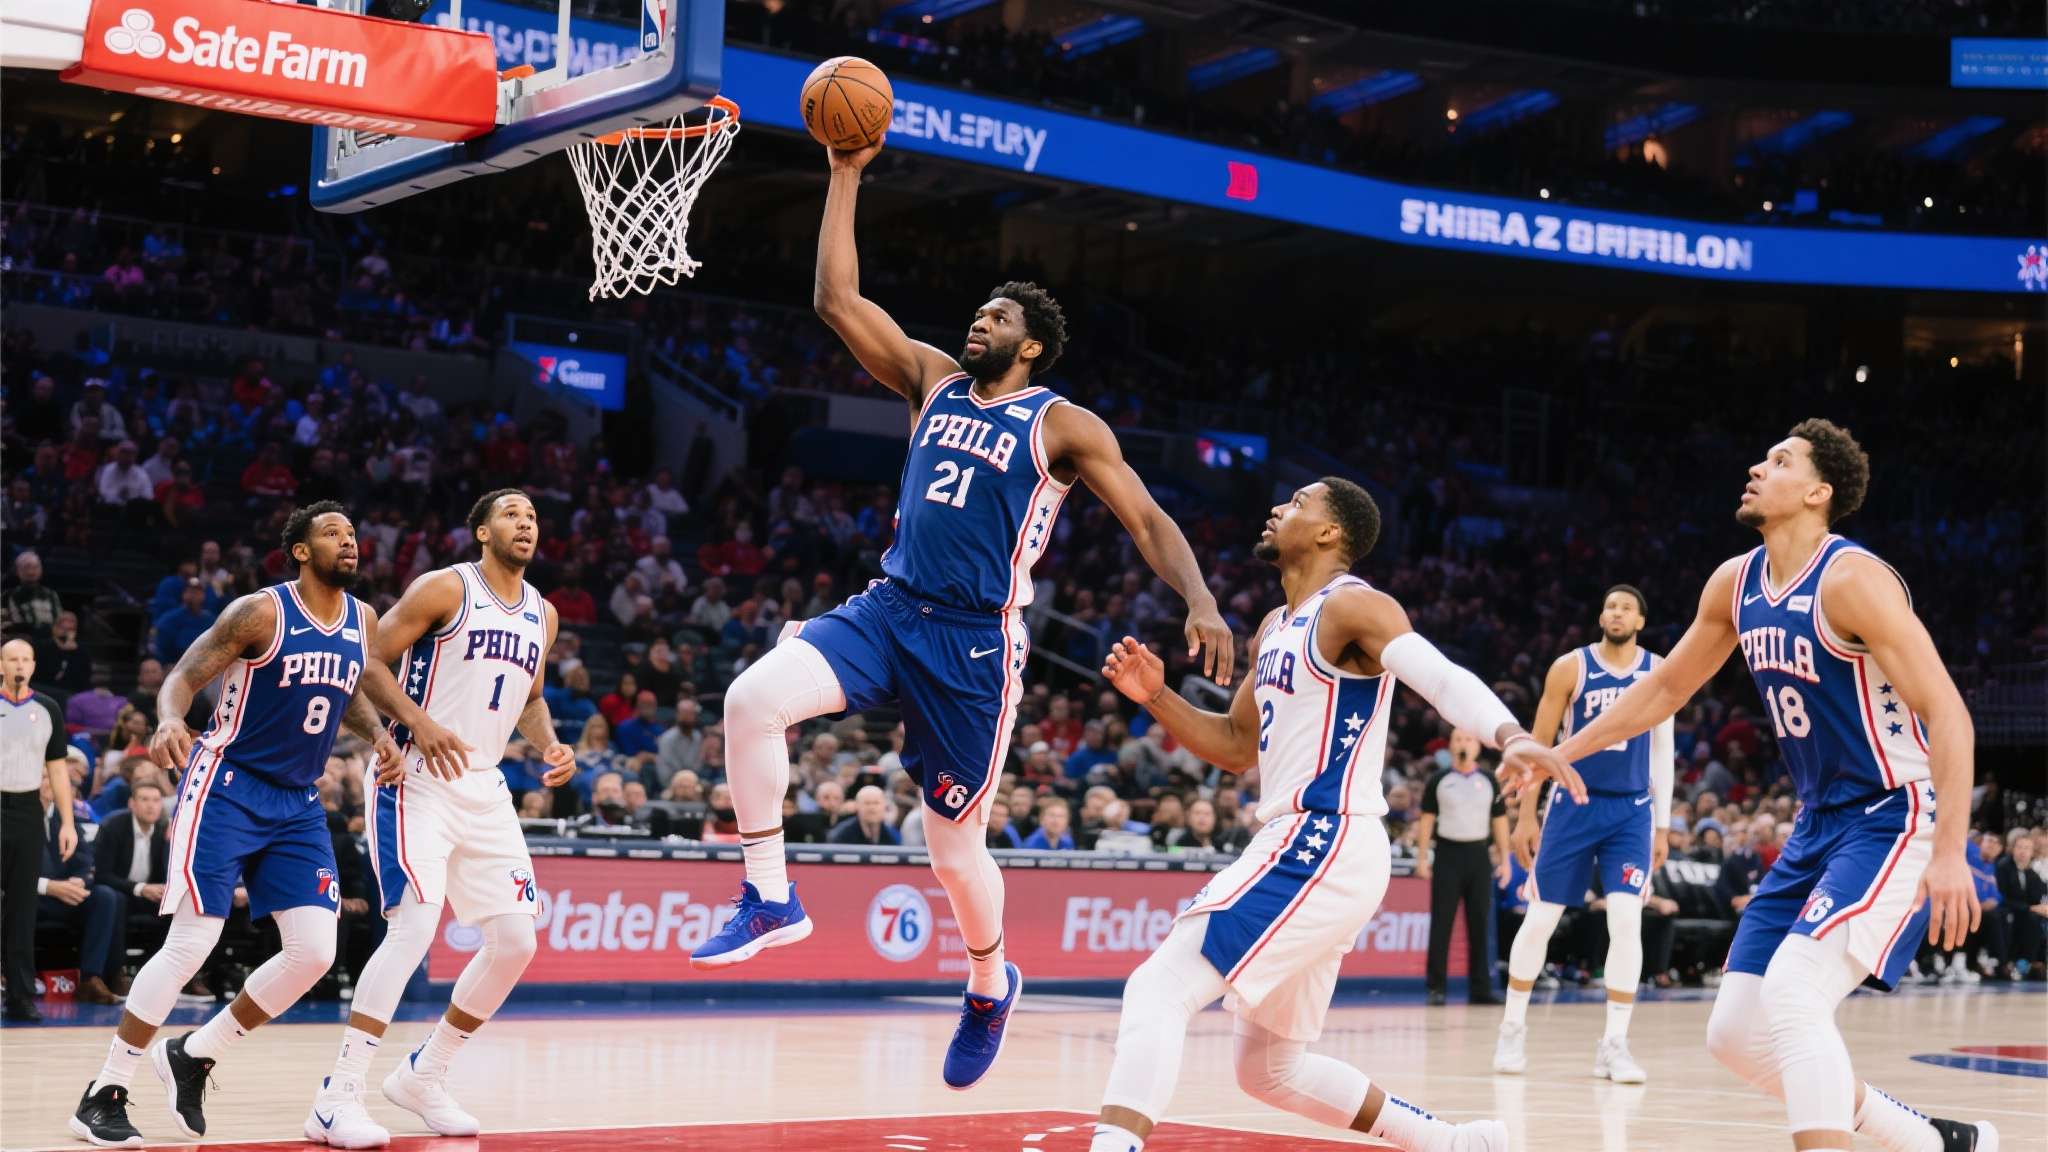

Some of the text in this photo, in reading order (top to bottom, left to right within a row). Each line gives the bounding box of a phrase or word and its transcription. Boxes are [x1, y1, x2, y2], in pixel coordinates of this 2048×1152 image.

[167, 15, 261, 73] Sate
[261, 30, 368, 88] Farm
[919, 413, 1018, 473] PHILA
[925, 460, 976, 509] 21
[278, 651, 360, 697] PHILA
[463, 629, 540, 680] PHILA
[1739, 626, 1821, 684] PHILA
[303, 695, 331, 735] 8
[488, 673, 505, 711] 1
[1766, 685, 1811, 738] 18
[1260, 699, 1274, 752] 2
[513, 877, 535, 902] 76
[879, 906, 920, 944] 76
